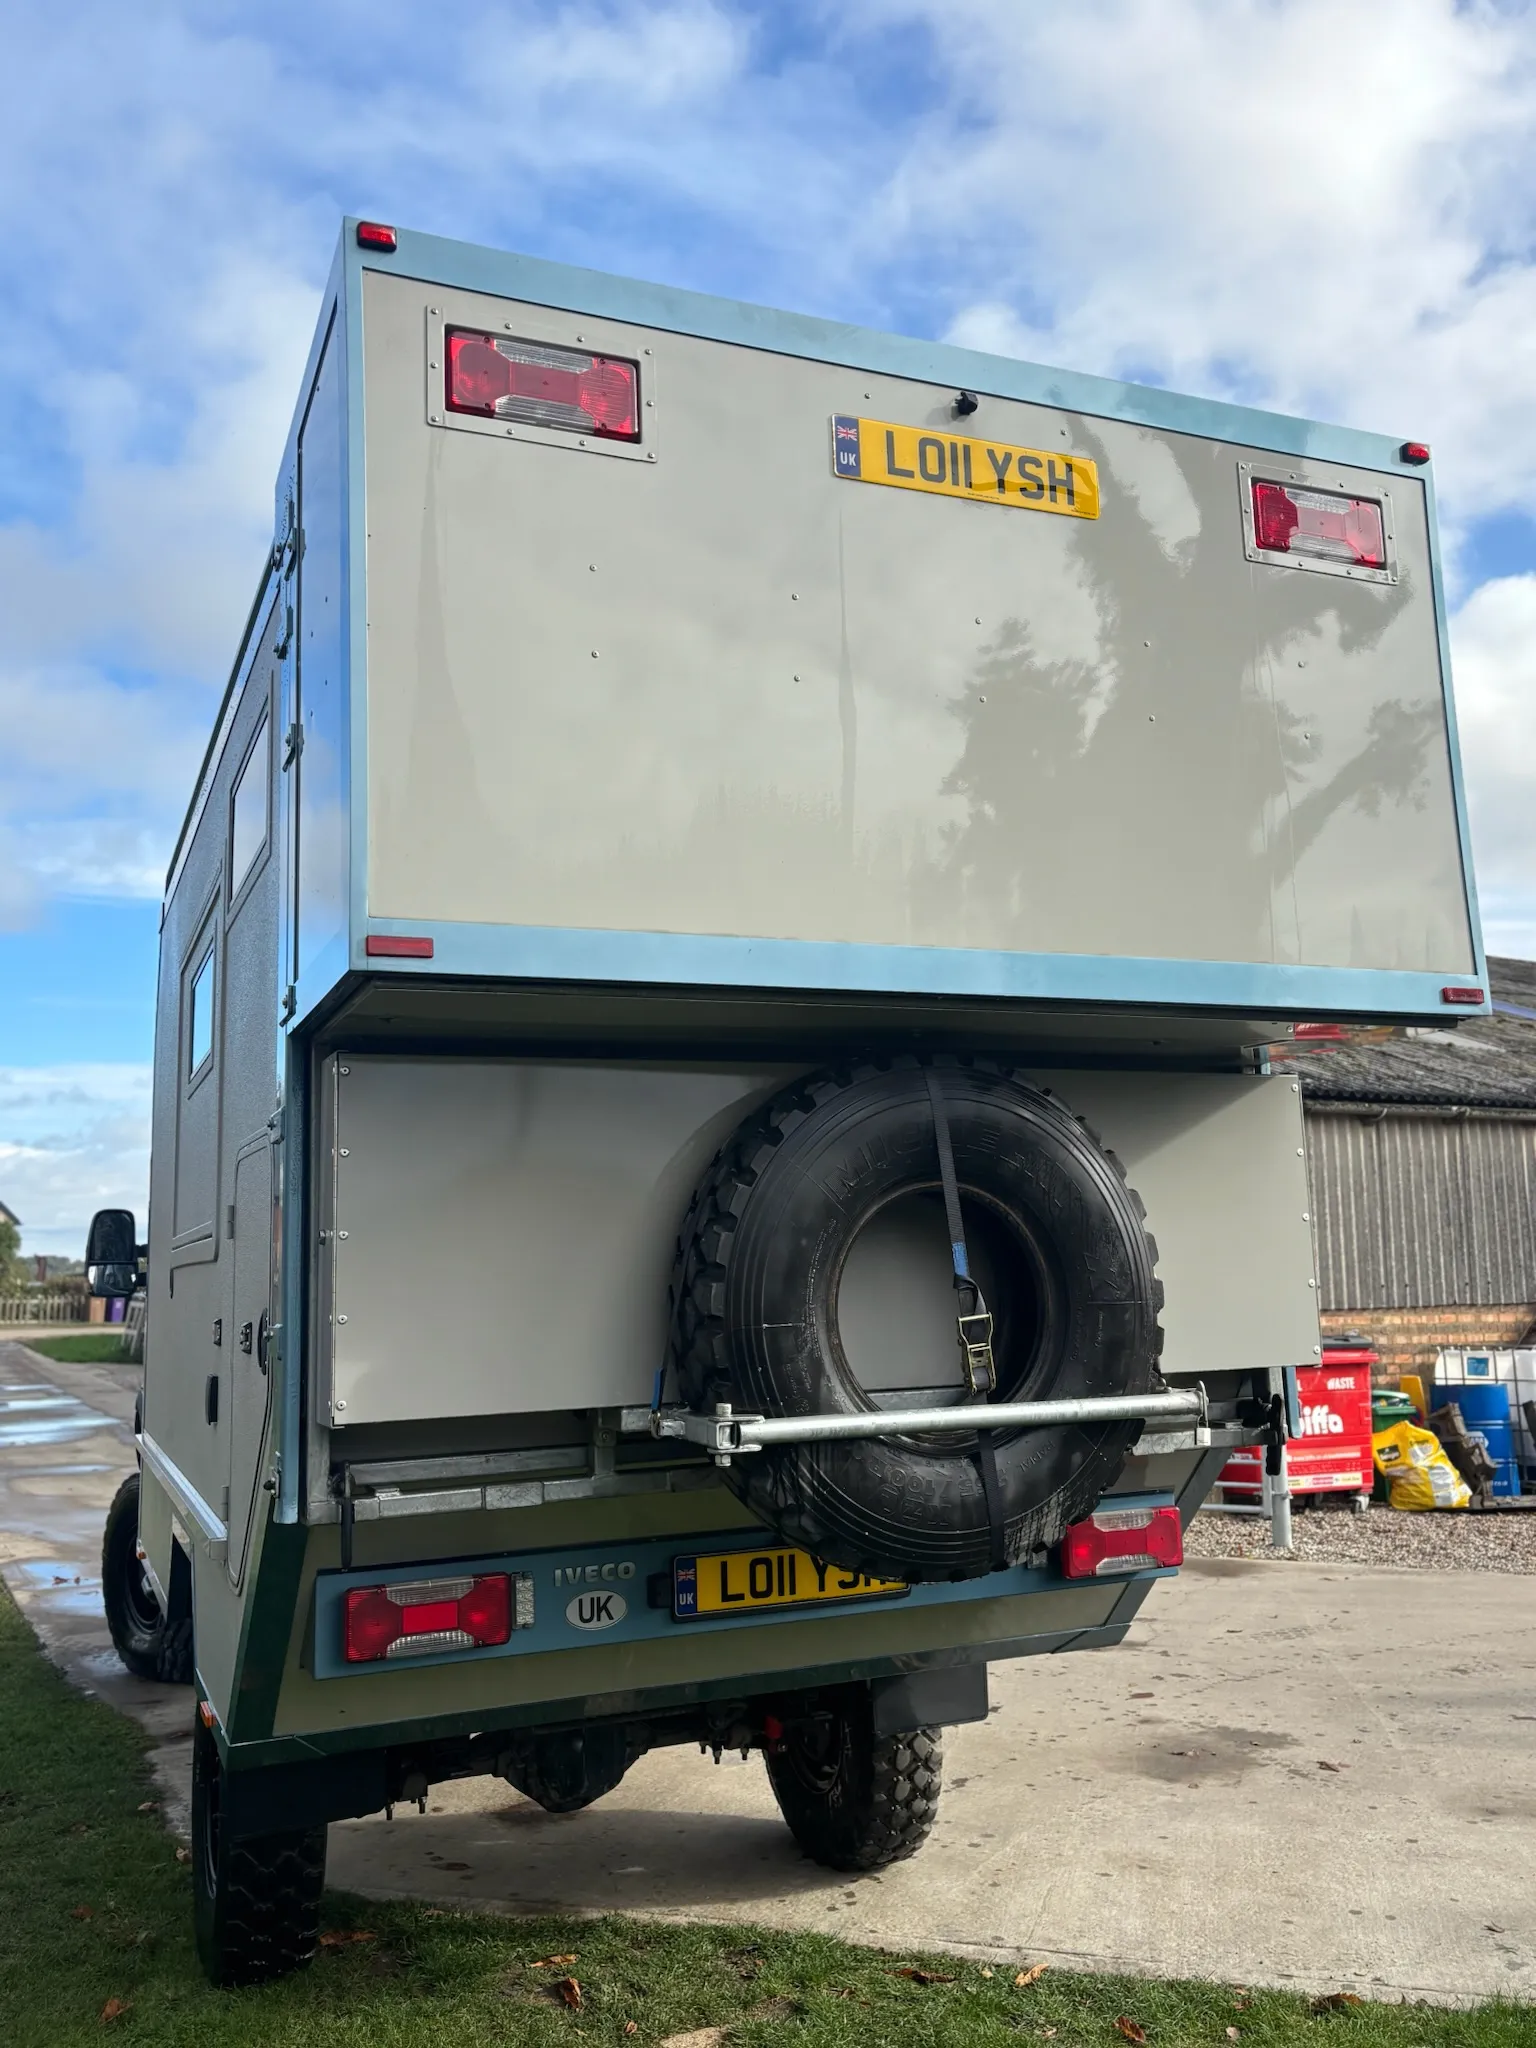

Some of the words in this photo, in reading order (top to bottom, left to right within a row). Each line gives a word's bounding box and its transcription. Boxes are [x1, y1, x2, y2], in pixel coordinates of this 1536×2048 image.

[840, 452, 857, 467] UK
[986, 448, 1075, 506] YSH
[1327, 1377, 1355, 1390] WASTE
[553, 1561, 636, 1587] IVECO
[577, 1594, 615, 1624] UK
[679, 1593, 694, 1605] UK
